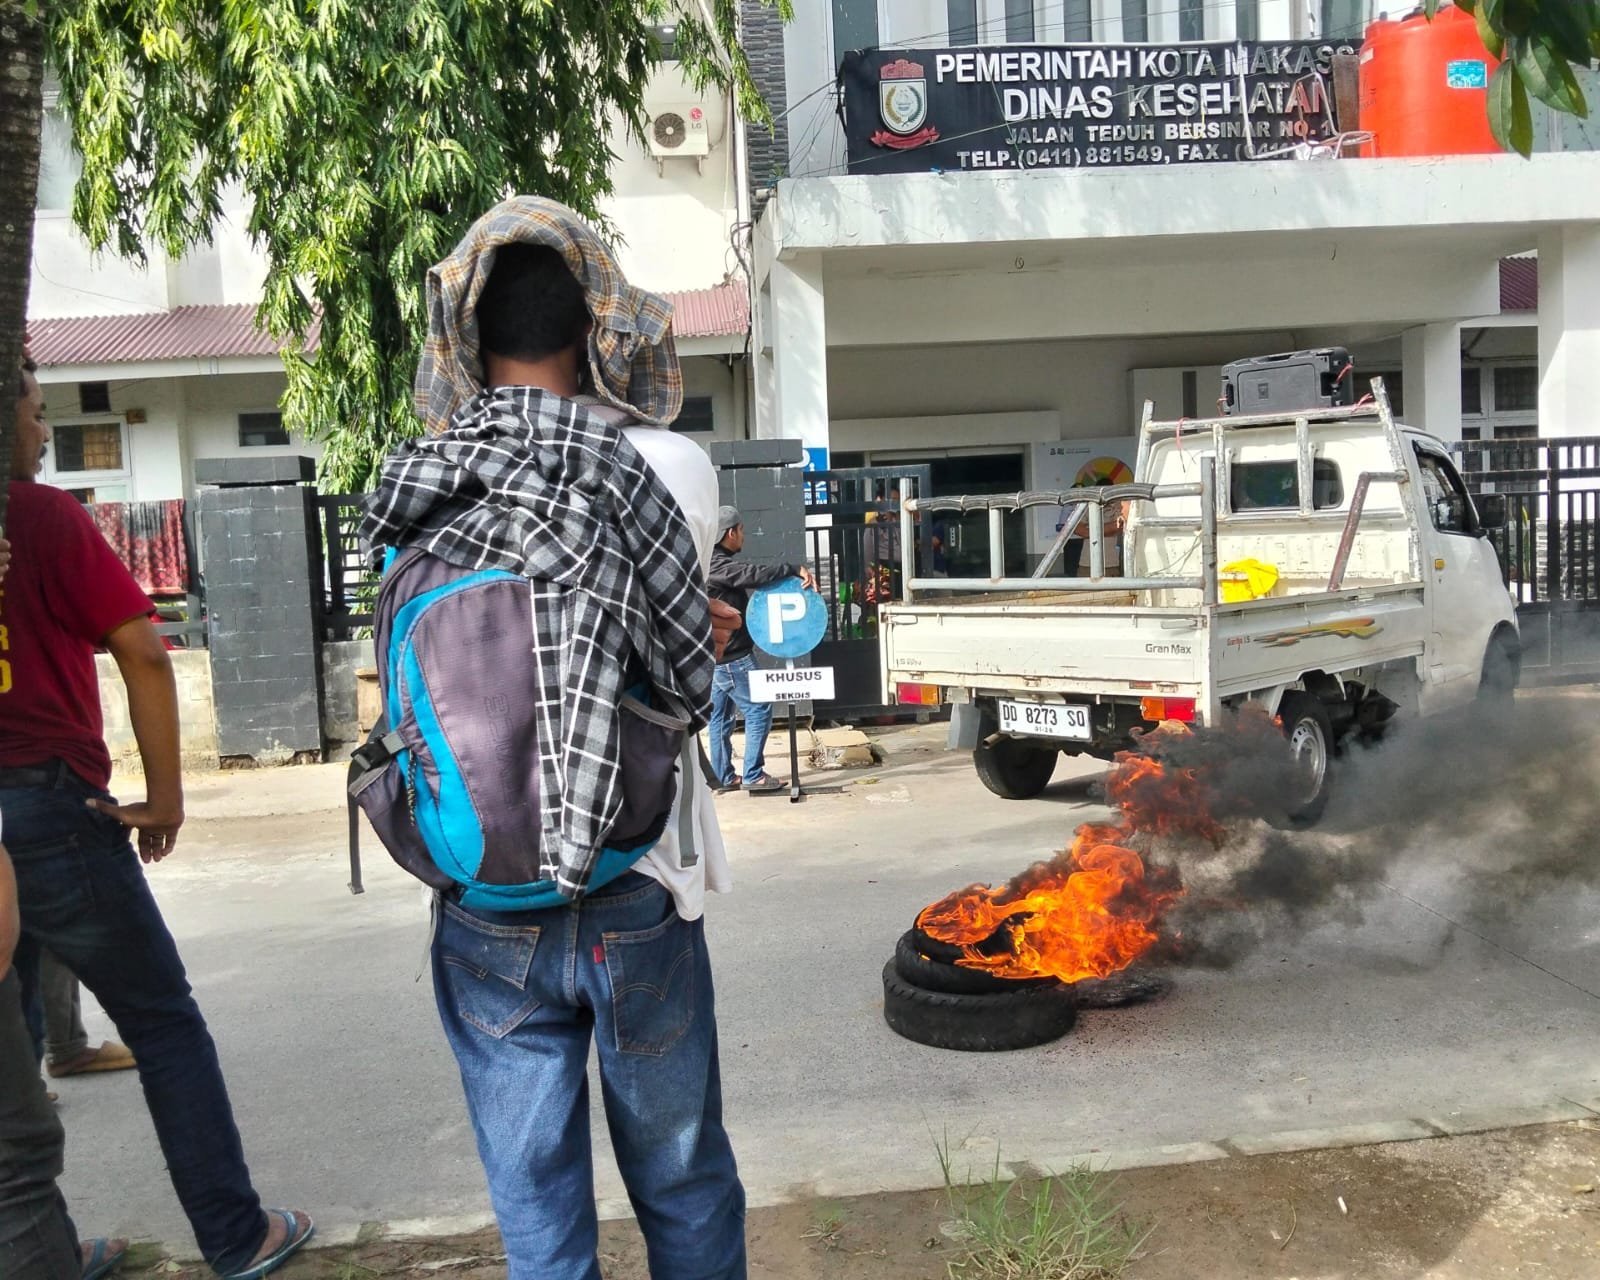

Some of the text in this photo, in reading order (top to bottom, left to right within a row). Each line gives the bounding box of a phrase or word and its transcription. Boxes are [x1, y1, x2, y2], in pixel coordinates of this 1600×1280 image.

[935, 45, 1355, 83] PEMERINTAH KOTA MAKAS
[1003, 85, 1114, 122] DINAS
[691, 122, 702, 130] LG
[1005, 125, 1074, 146] JALAN
[1085, 123, 1155, 142] TEDUH
[1164, 120, 1271, 140] BERSINAR
[1279, 120, 1316, 138] NO.
[1085, 144, 1171, 166] 881549,
[1178, 142, 1229, 161] FAX.
[767, 592, 807, 644] P
[1145, 642, 1192, 655] Gran Max
[765, 670, 822, 684] KHUSUS
[775, 691, 811, 701] SEKDIS
[1003, 704, 1018, 722] DD
[1026, 707, 1058, 726] 8273
